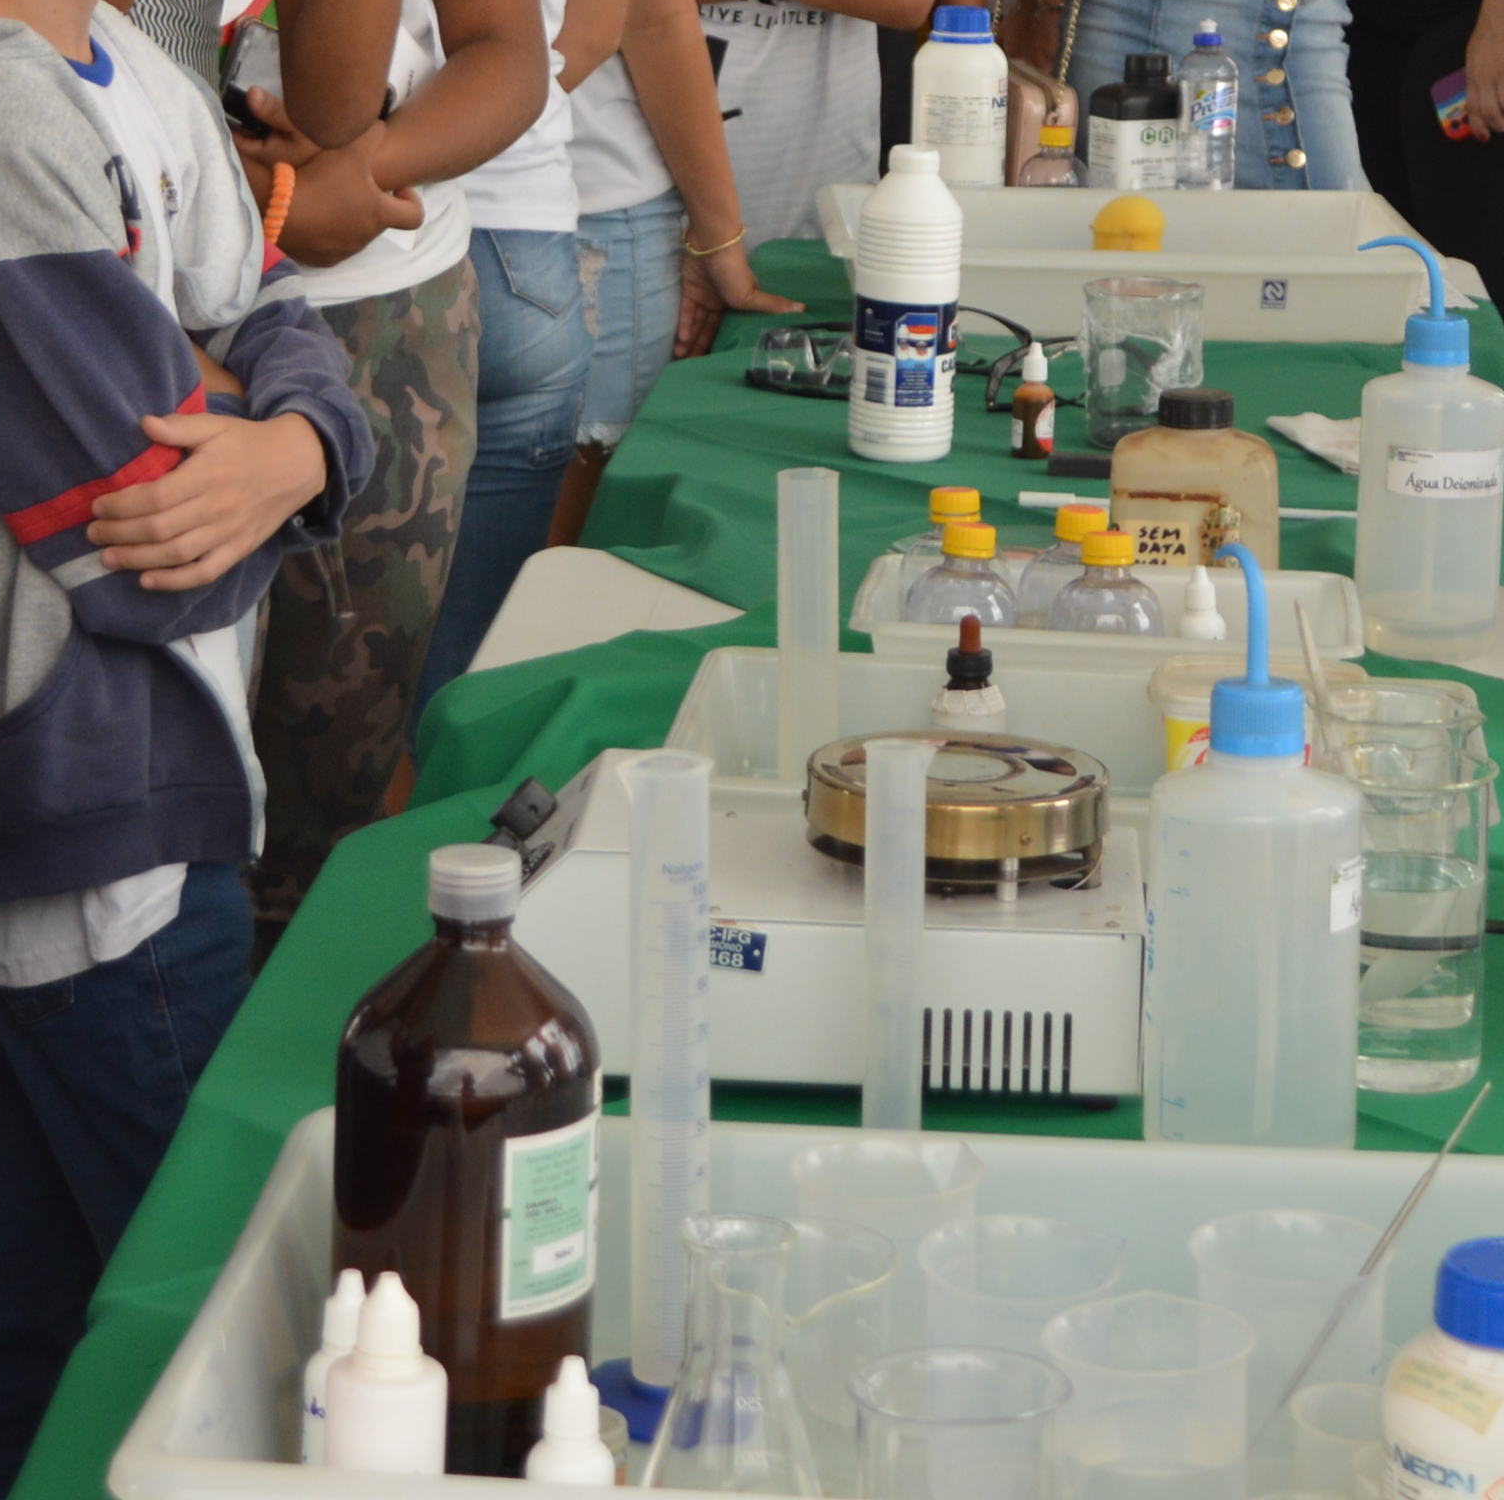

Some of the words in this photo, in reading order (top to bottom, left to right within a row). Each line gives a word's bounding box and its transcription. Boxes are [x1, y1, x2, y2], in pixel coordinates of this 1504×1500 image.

[1405, 471, 1439, 494] Água
[1442, 471, 1498, 491] Deionizada
[1138, 525, 1182, 541] SEM
[1137, 541, 1187, 556] DATA
[1394, 1444, 1476, 1494] NEON
